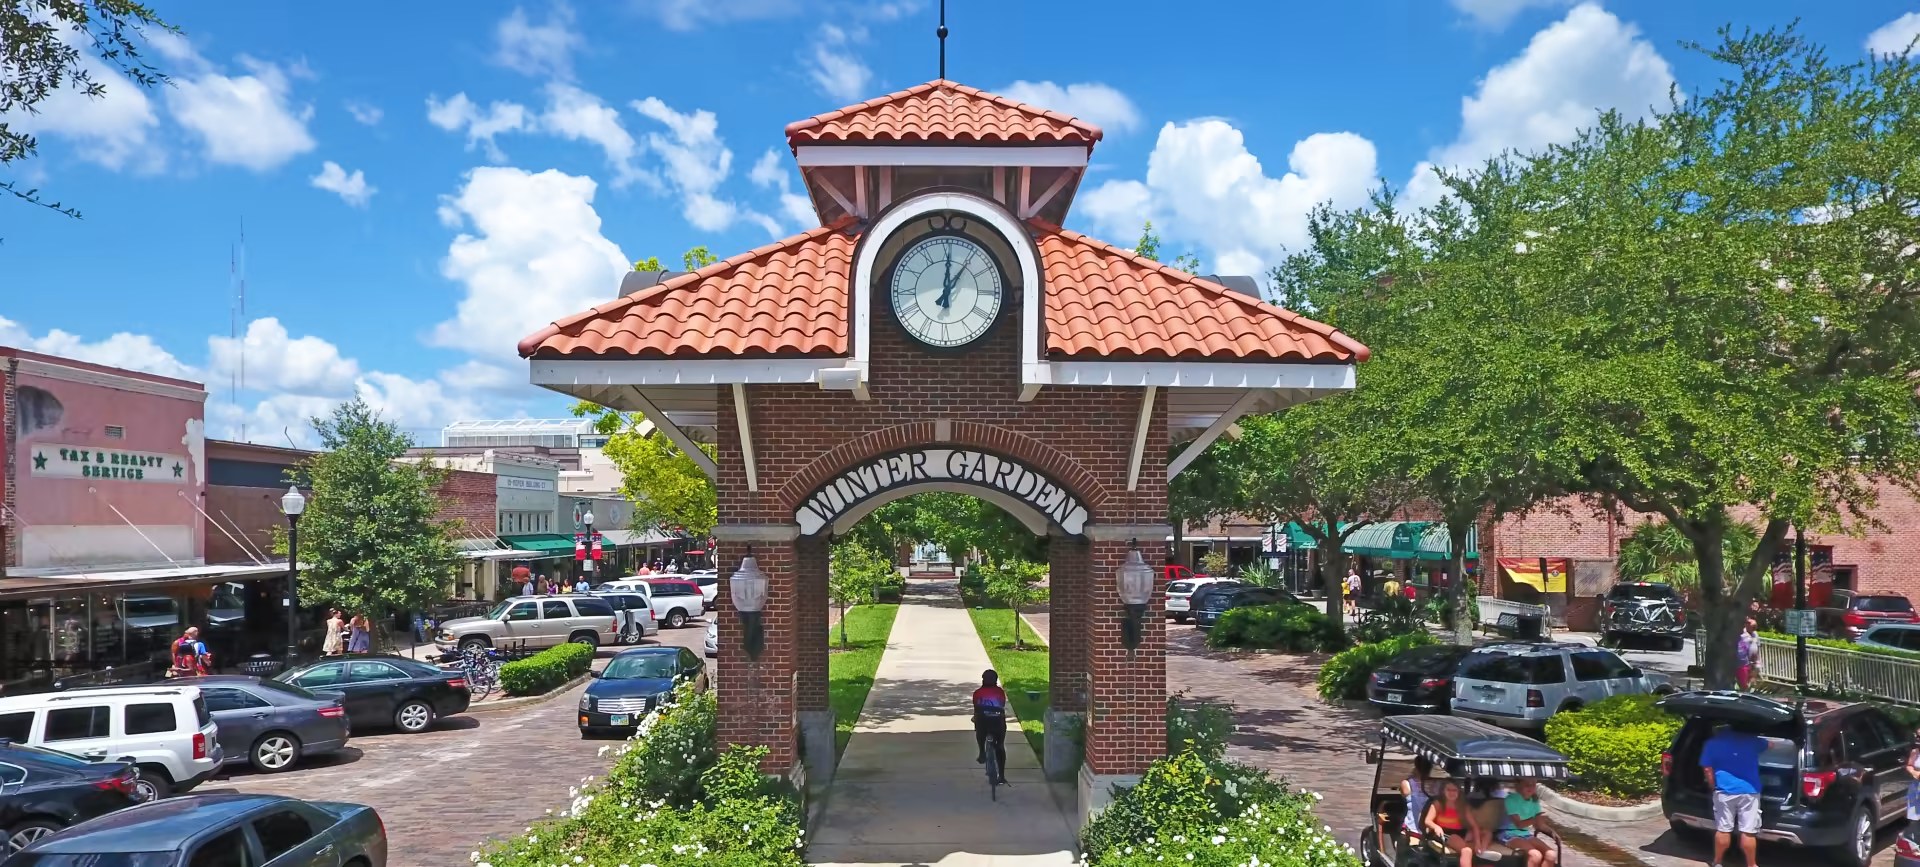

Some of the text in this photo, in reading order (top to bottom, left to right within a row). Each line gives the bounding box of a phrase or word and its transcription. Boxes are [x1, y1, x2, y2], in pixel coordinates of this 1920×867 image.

[60, 448, 90, 462] TAX
[111, 453, 164, 467] REALTY
[82, 465, 144, 480] SERVICE
[806, 450, 1079, 525] WINTER GARDEN
